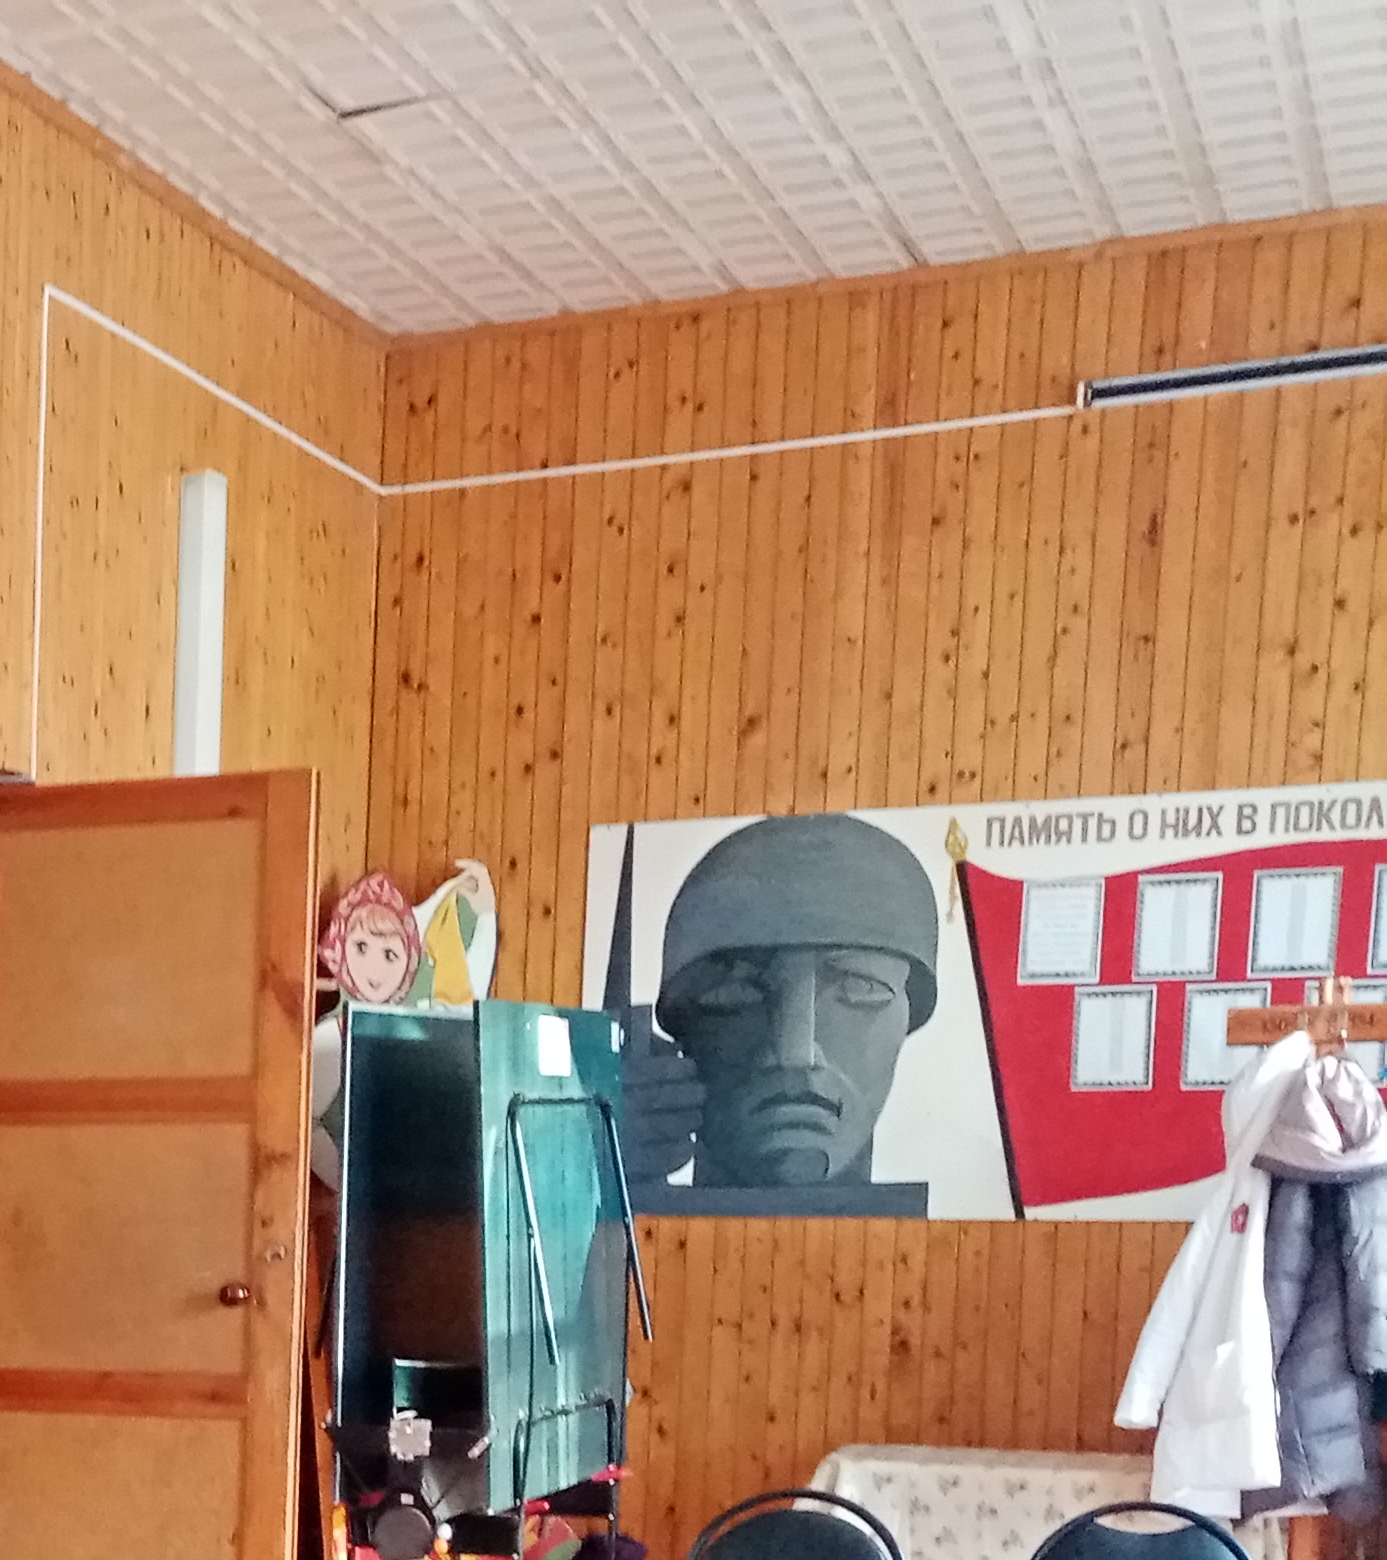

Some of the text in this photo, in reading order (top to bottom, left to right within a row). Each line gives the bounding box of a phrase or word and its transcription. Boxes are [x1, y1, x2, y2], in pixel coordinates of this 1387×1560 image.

[986, 811, 1117, 848] ПАМЯТЬ
[1128, 809, 1148, 840] О
[1160, 805, 1224, 839] НИХ
[1236, 803, 1258, 835] В
